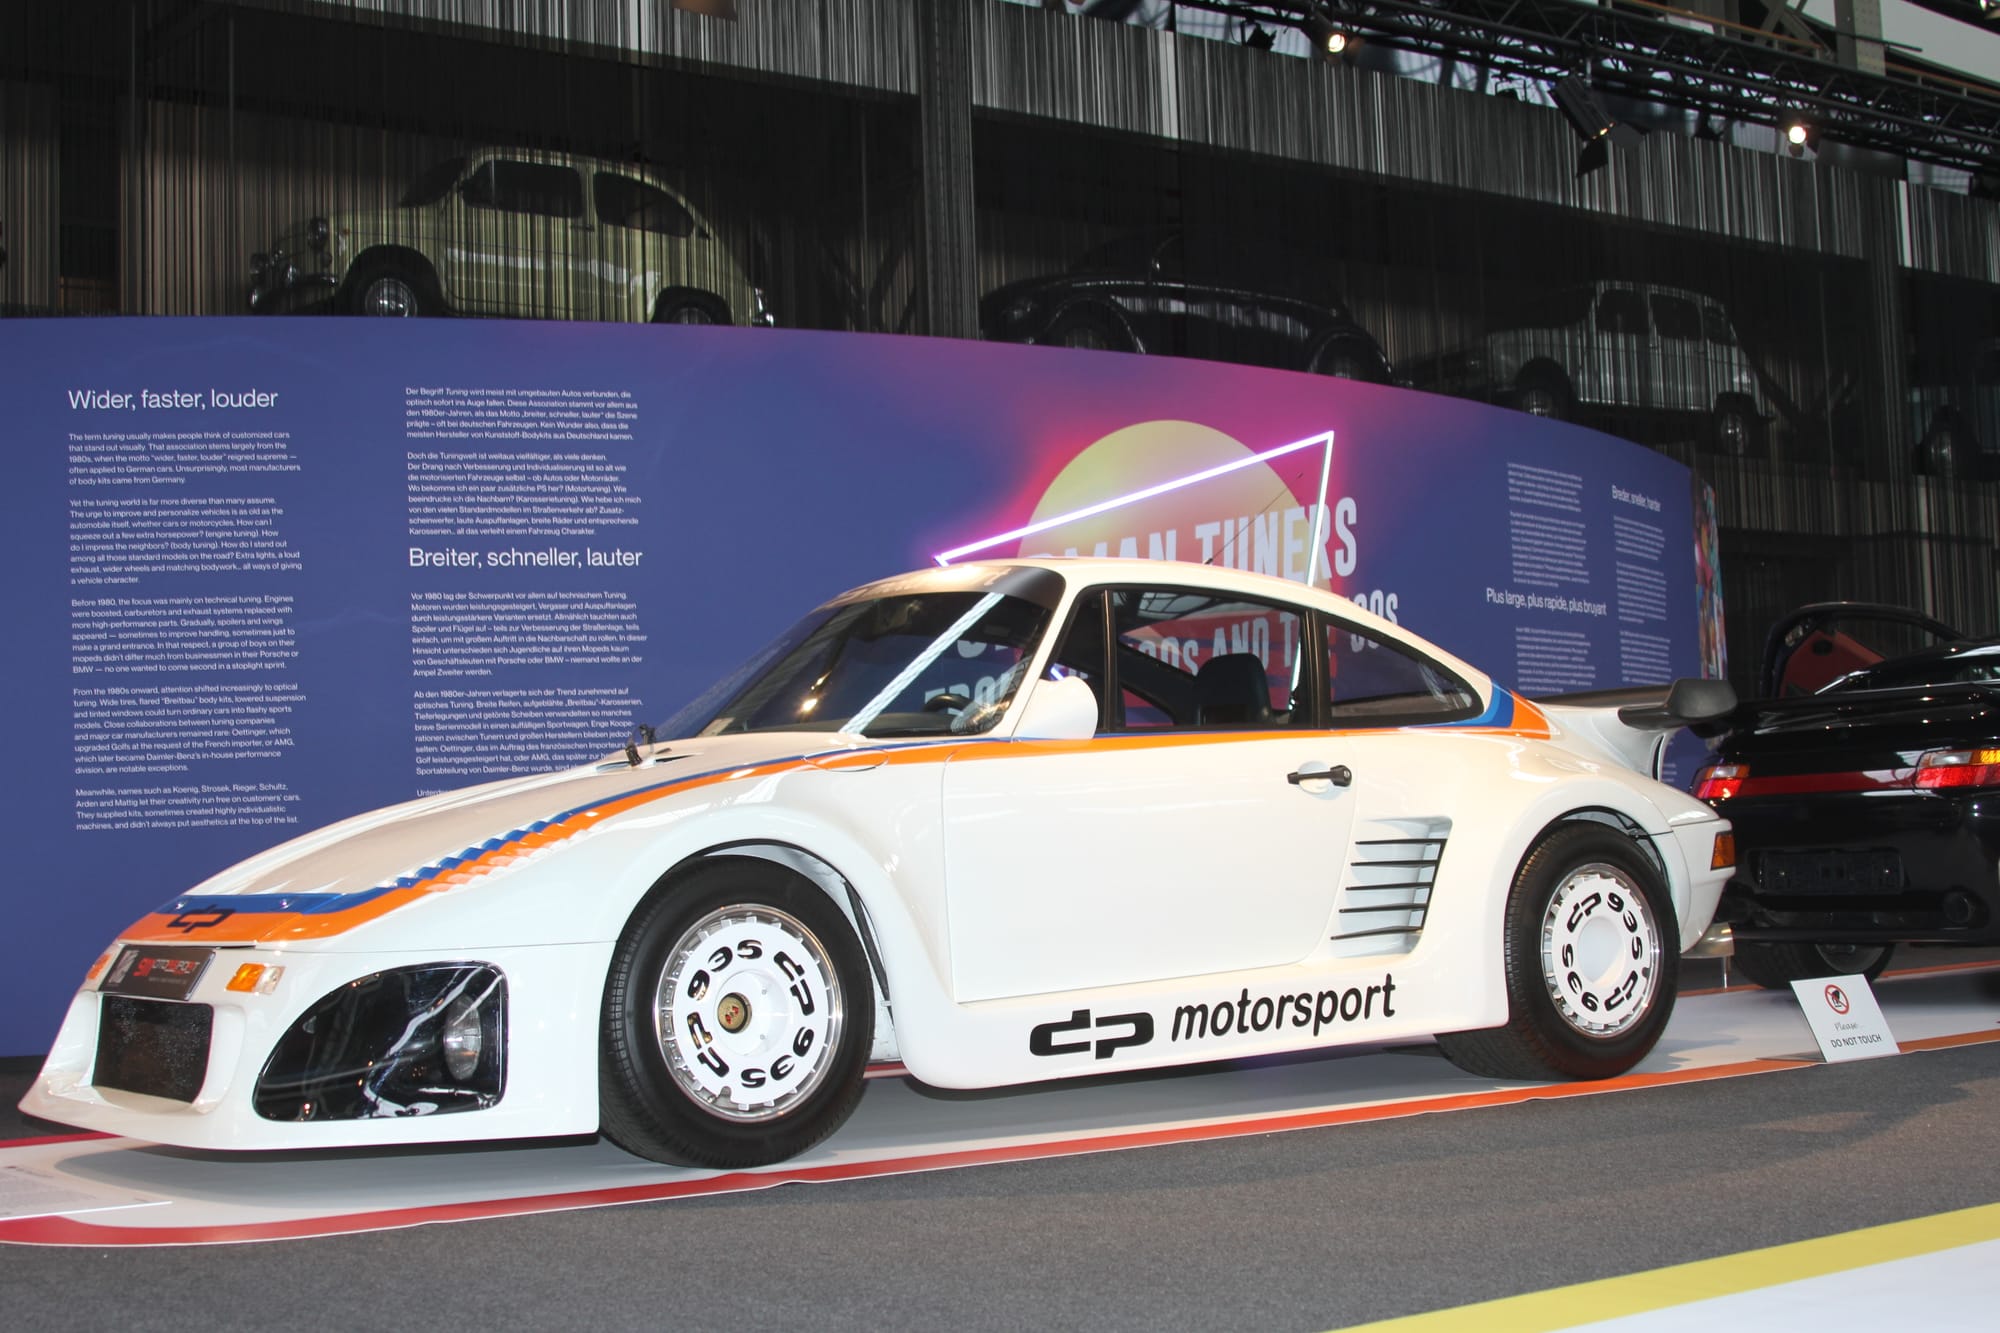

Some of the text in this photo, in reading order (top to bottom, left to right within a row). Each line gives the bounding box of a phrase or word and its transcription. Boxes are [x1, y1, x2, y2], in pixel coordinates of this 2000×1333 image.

[405, 387, 419, 396] Der
[419, 387, 444, 397] Begriff
[445, 387, 469, 397] Tuning
[561, 390, 582, 398] Autos
[68, 388, 278, 411] Wider, faster, louder
[405, 398, 433, 407] optisch
[466, 399, 486, 408] Auge
[506, 399, 528, 407] Diese
[405, 409, 421, 417] den
[616, 411, 638, 420] Szene
[68, 432, 84, 441] The
[102, 433, 126, 442] tuning
[125, 432, 152, 441] usually
[222, 431, 231, 440] of
[435, 430, 470, 439] Hersteller
[566, 432, 610, 440] Deutschland
[68, 444, 84, 452] that
[148, 442, 165, 451] That
[231, 442, 256, 451] largely
[256, 442, 274, 450] from
[274, 442, 287, 450] the
[227, 454, 256, 462] reigned
[68, 466, 89, 474] often
[89, 466, 117, 475] applied
[125, 465, 156, 473] German
[68, 477, 77, 486] of
[77, 477, 97, 486] body
[133, 476, 151, 484] from
[1195, 497, 1357, 580] TUNERS
[409, 548, 642, 568] Breiter, schneller, lauter
[410, 603, 442, 611] Motoren
[538, 602, 569, 611] Vergaser
[584, 602, 637, 610] Auspuffanlagen
[1486, 587, 1607, 616] Plus large, plus rapide, plus bruyant
[1212, 616, 1269, 672] AND
[99, 698, 119, 706] Wide
[138, 697, 161, 706] flared
[198, 696, 218, 704] body
[234, 695, 264, 703] lowered
[264, 694, 307, 702] suspension
[143, 787, 162, 795] such
[1171, 974, 1396, 1042] motorsport
[1830, 1034, 1881, 1048] DO NOT TOUCH
